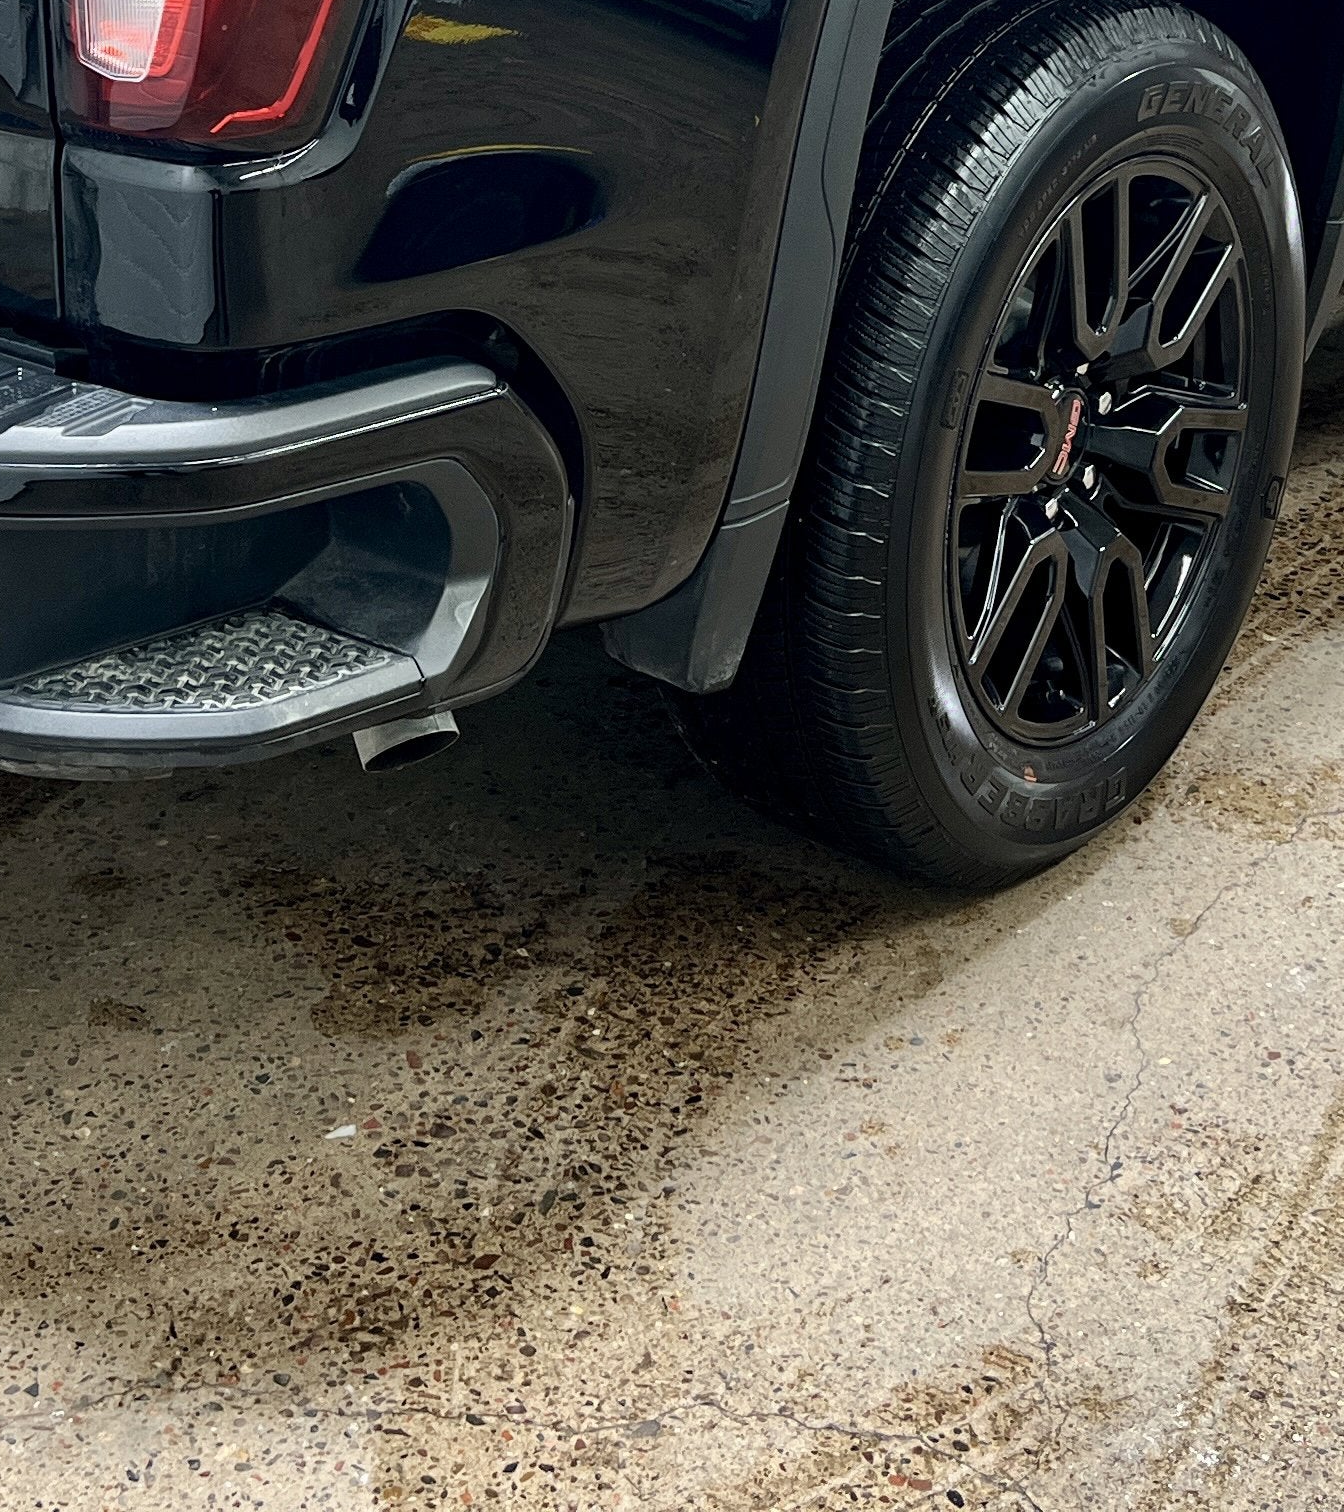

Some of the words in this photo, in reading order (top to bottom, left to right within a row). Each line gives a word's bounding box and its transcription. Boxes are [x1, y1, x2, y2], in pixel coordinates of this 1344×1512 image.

[1137, 80, 1276, 190] GENERAL
[1052, 399, 1082, 476] GMC
[960, 755, 1128, 833] GRABBER
